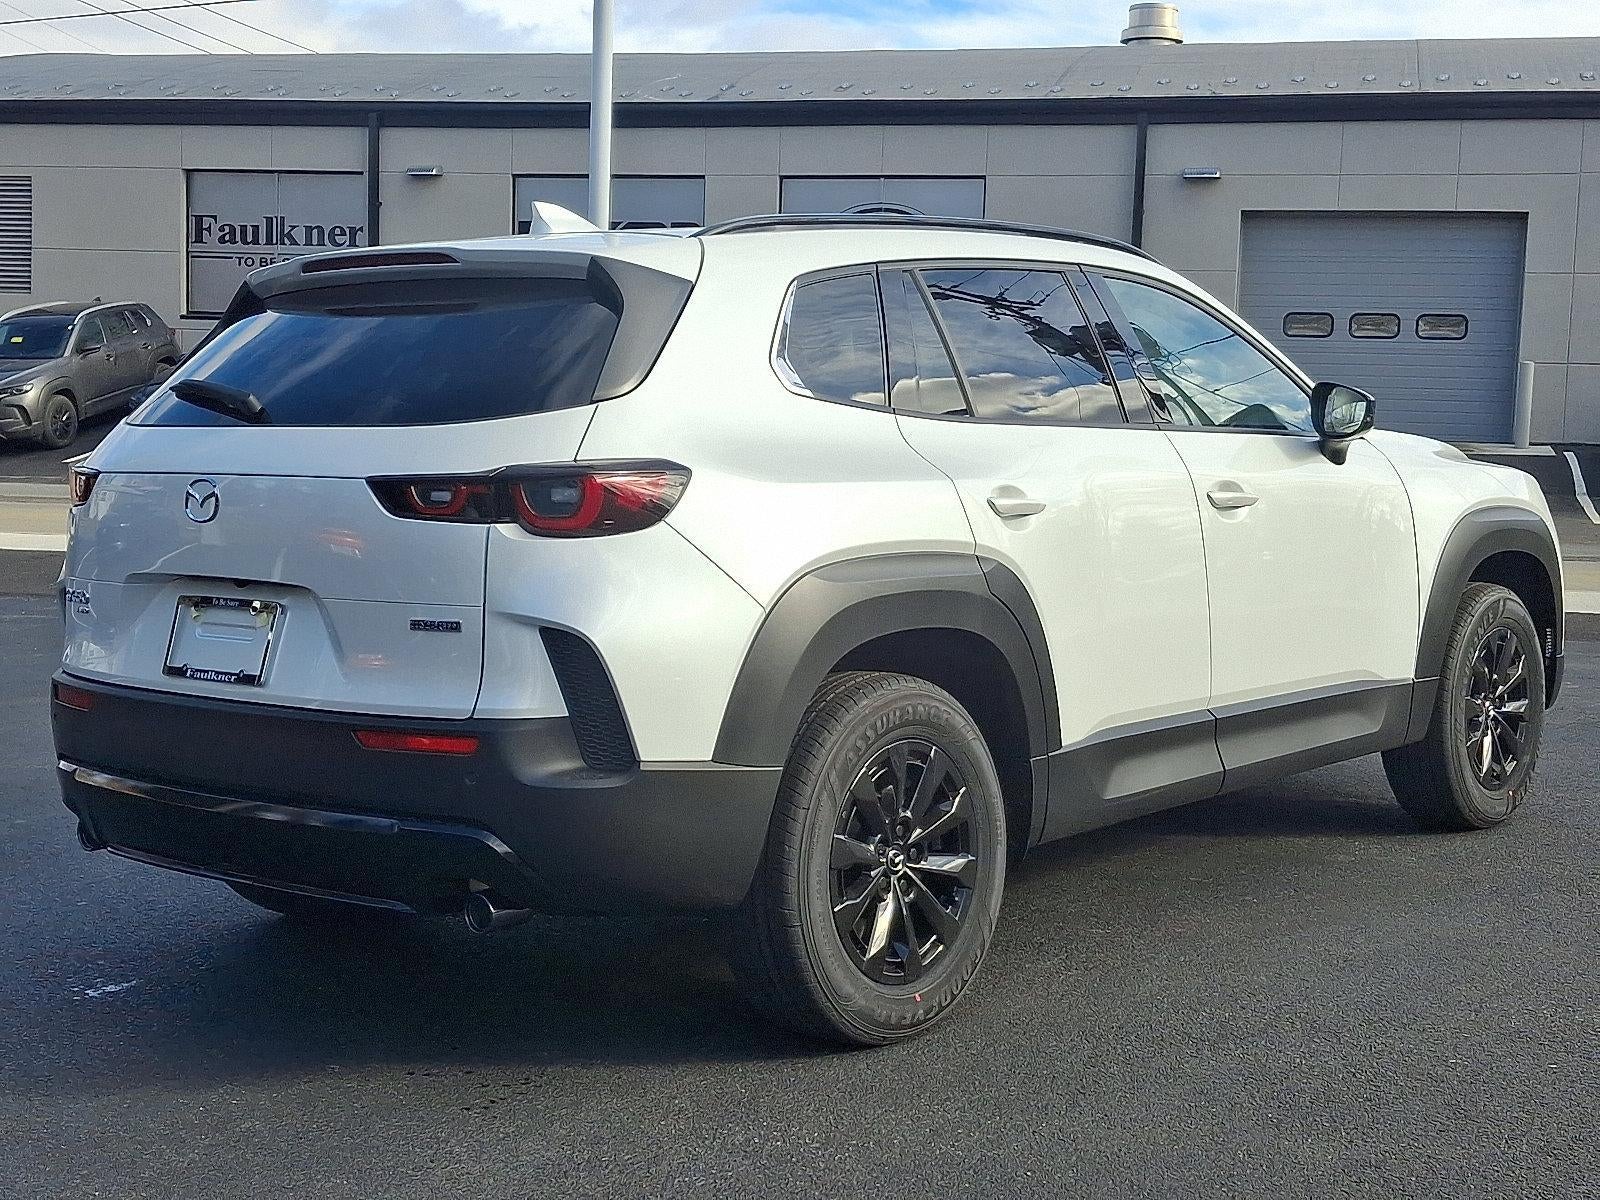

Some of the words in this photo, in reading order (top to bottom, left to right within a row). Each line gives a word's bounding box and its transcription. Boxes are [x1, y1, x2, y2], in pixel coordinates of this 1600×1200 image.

[190, 214, 364, 248] Faulkner
[235, 256, 255, 268] TO
[259, 256, 277, 267] BE
[185, 668, 238, 683] Faulkner
